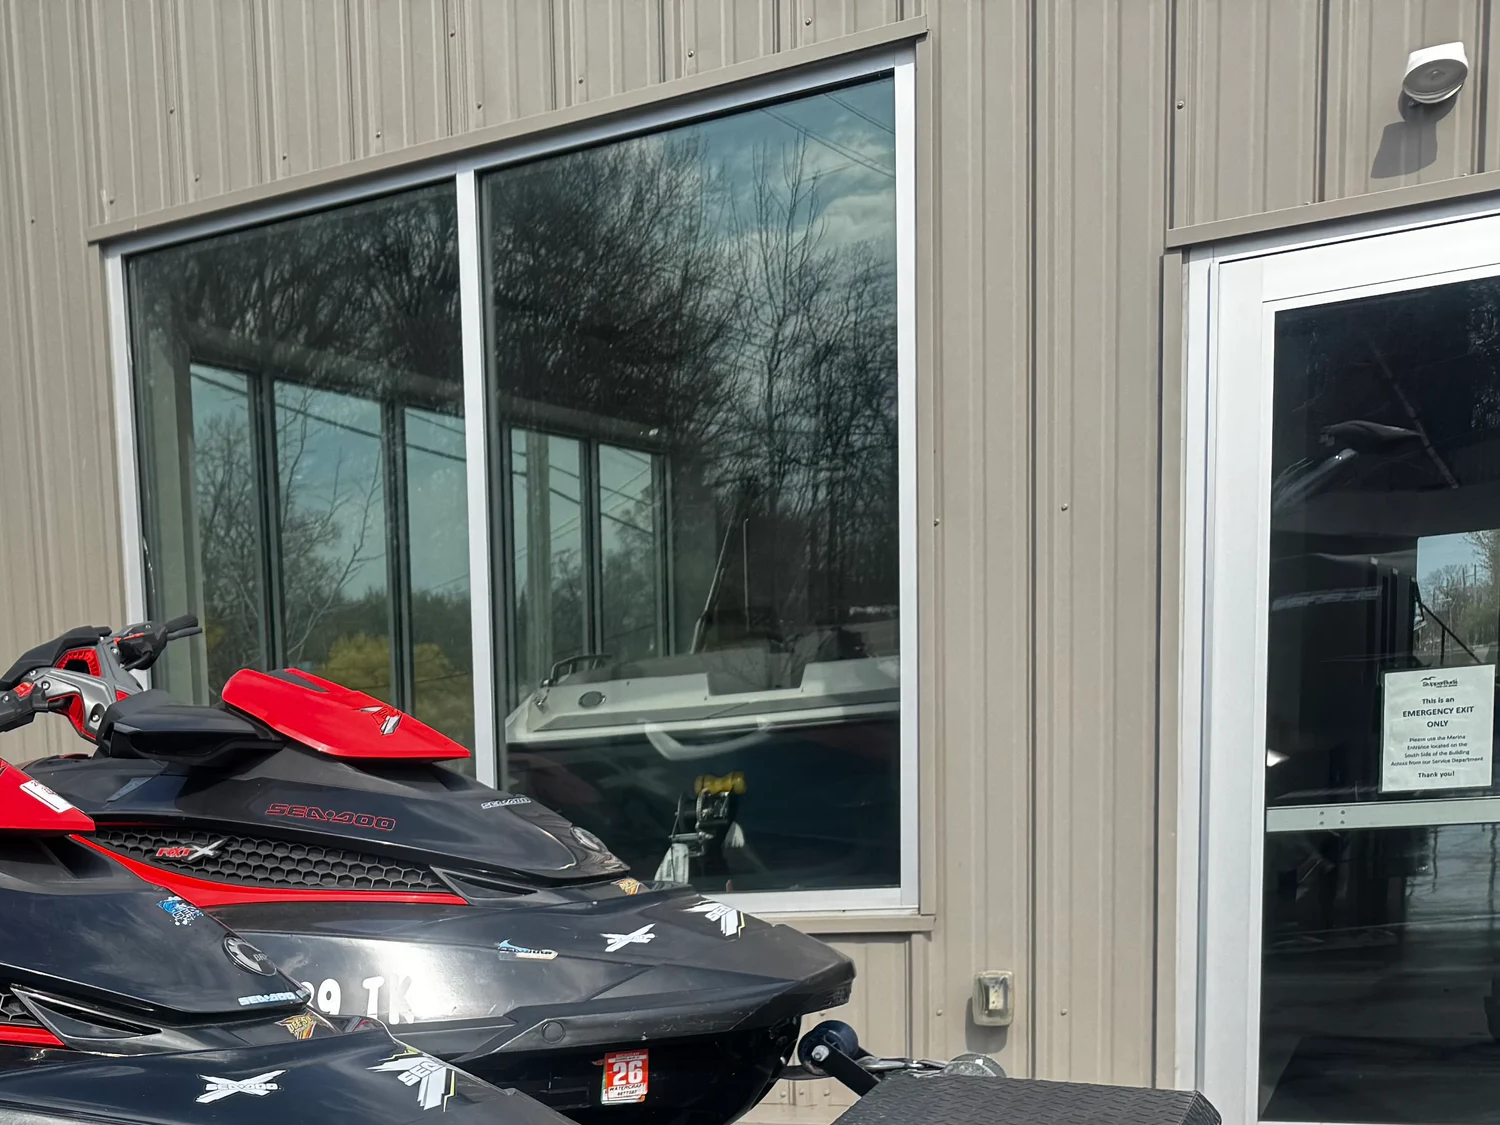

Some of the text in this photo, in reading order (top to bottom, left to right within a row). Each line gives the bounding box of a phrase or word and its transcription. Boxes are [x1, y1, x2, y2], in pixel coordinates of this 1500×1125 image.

[1402, 706, 1474, 717] EMERGENCY EXIT
[1426, 720, 1449, 728] ONLY
[362, 974, 416, 1025] TK
[612, 1060, 643, 1086] 26
